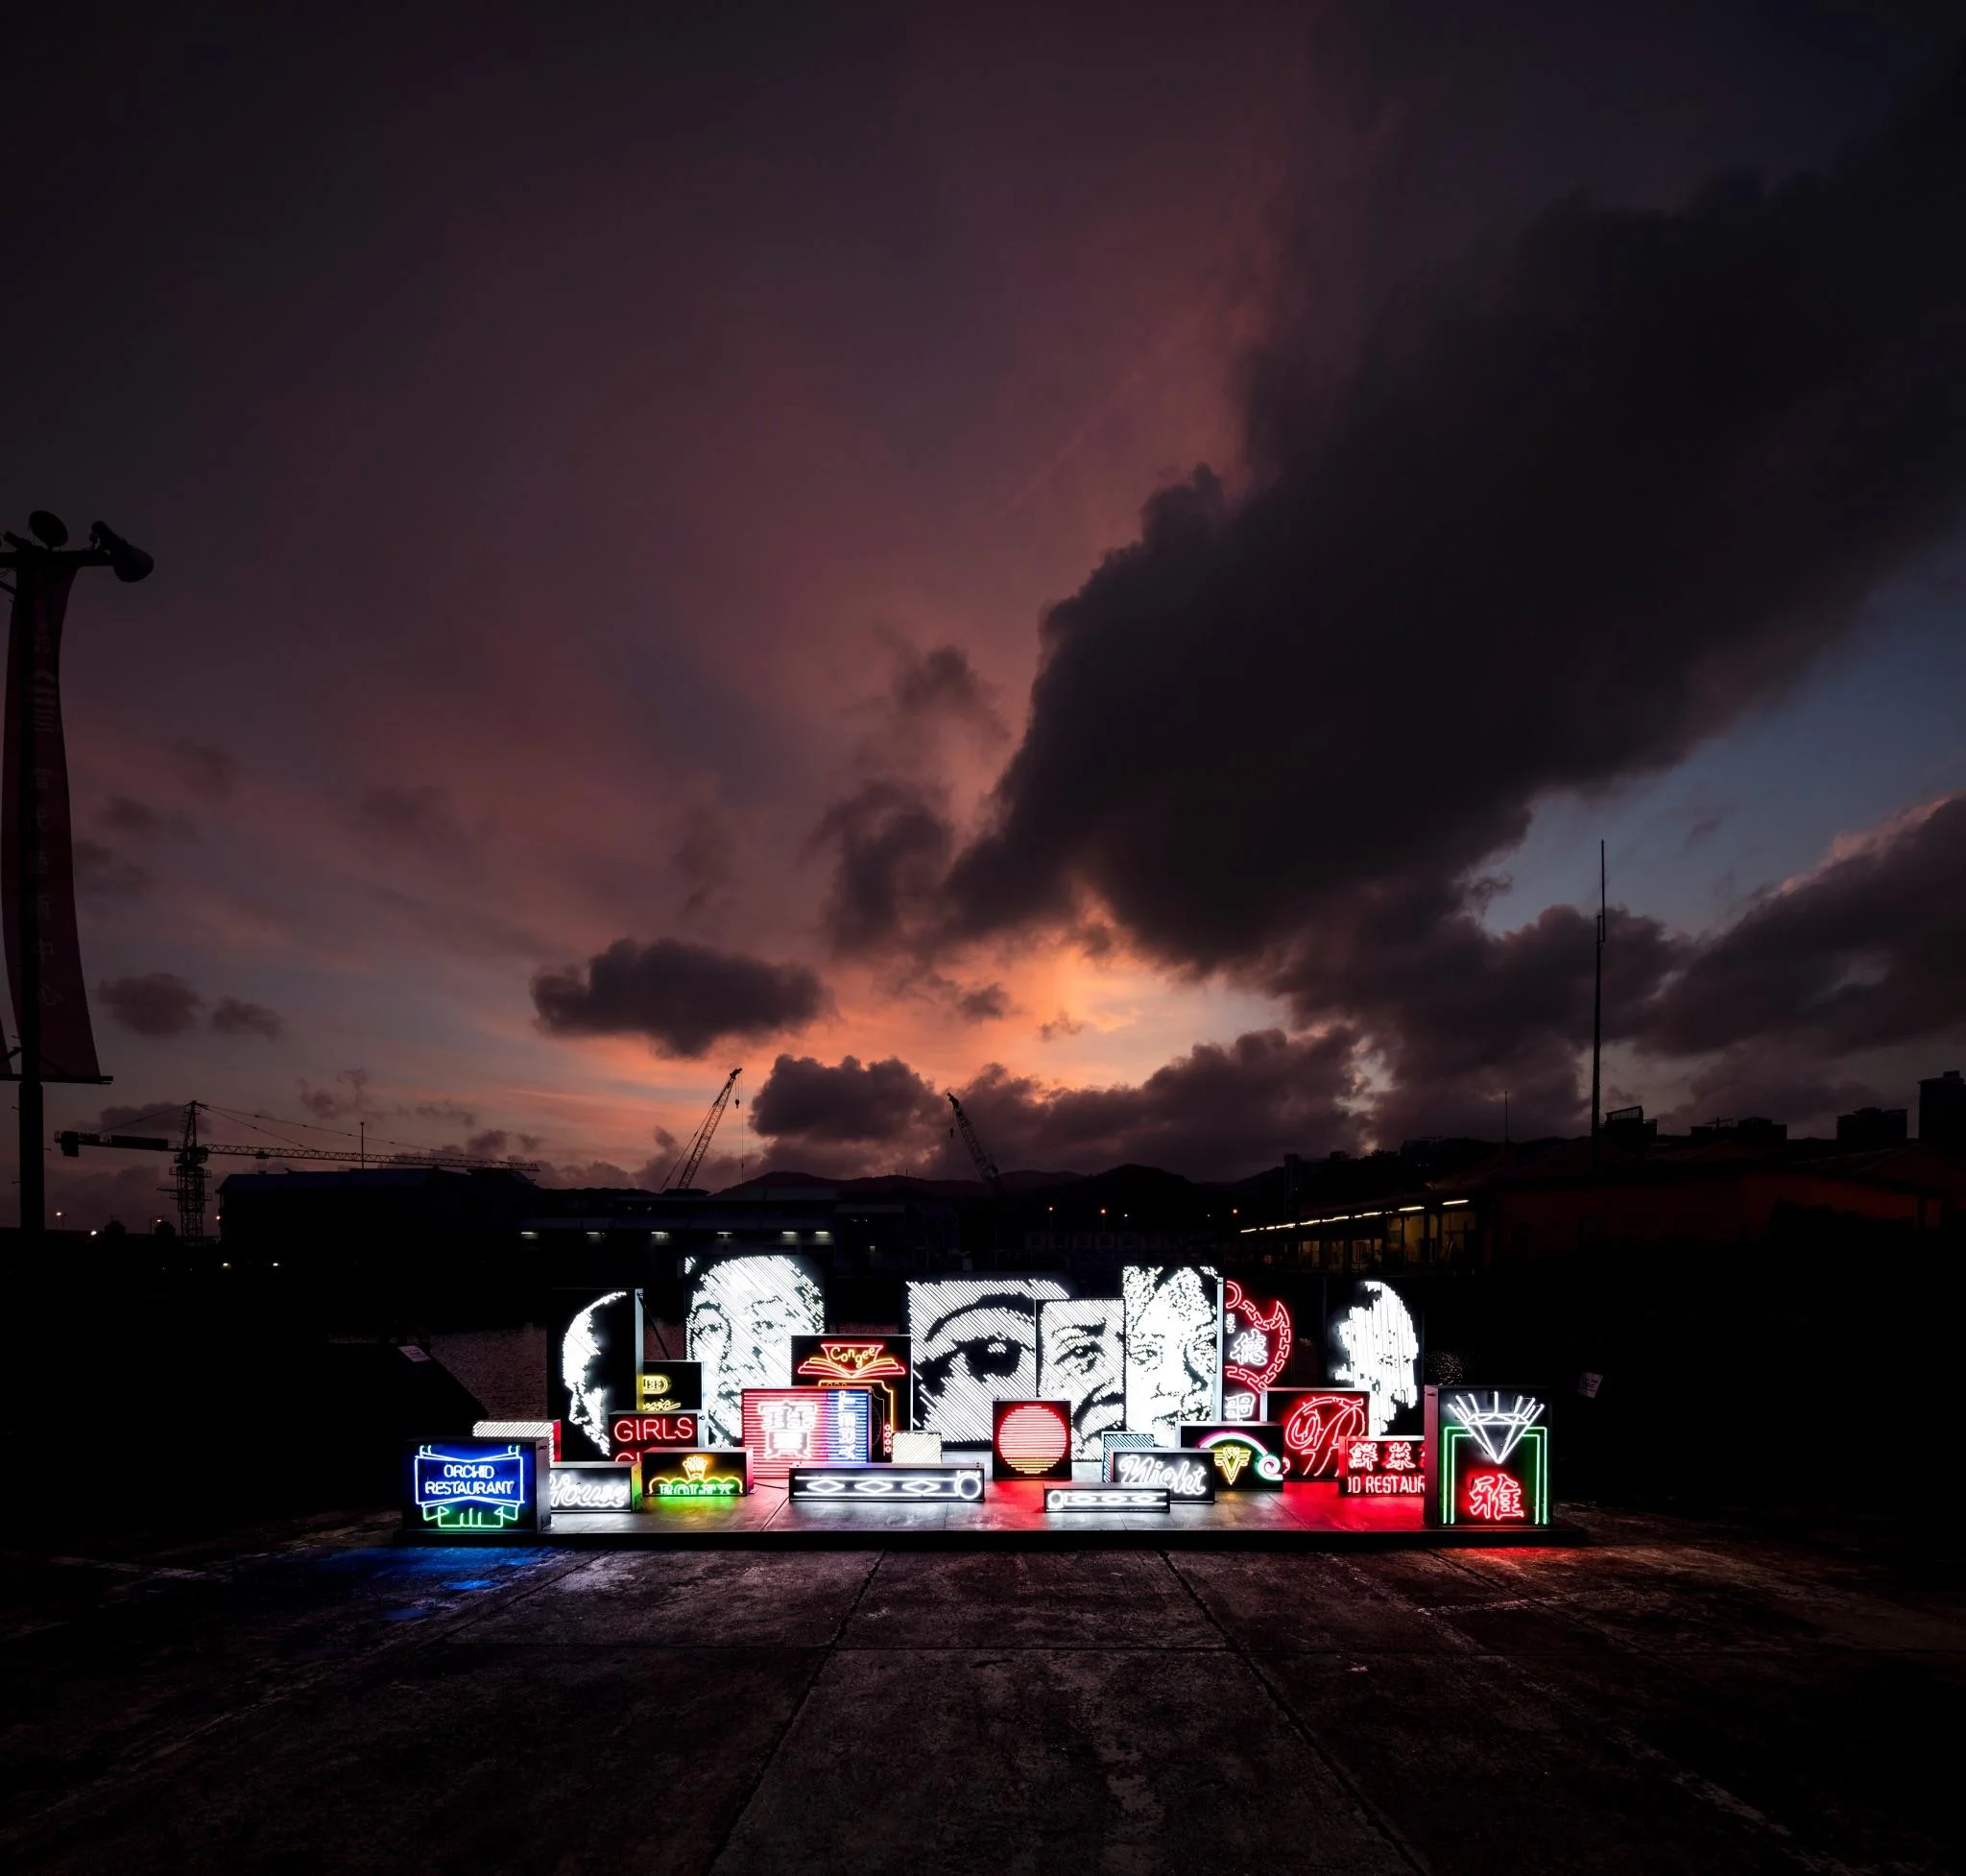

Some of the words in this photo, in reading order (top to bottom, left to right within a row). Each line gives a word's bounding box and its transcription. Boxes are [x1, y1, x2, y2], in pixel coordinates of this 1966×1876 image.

[828, 1346, 875, 1369] Congee
[613, 1416, 693, 1442] GIRLS
[1349, 1442, 1425, 1471] 鮮菜
[444, 1464, 494, 1479] ORCHID
[1118, 1455, 1207, 1495] Night
[424, 1480, 515, 1495] RESTAURANT
[1469, 1474, 1524, 1521] 雅
